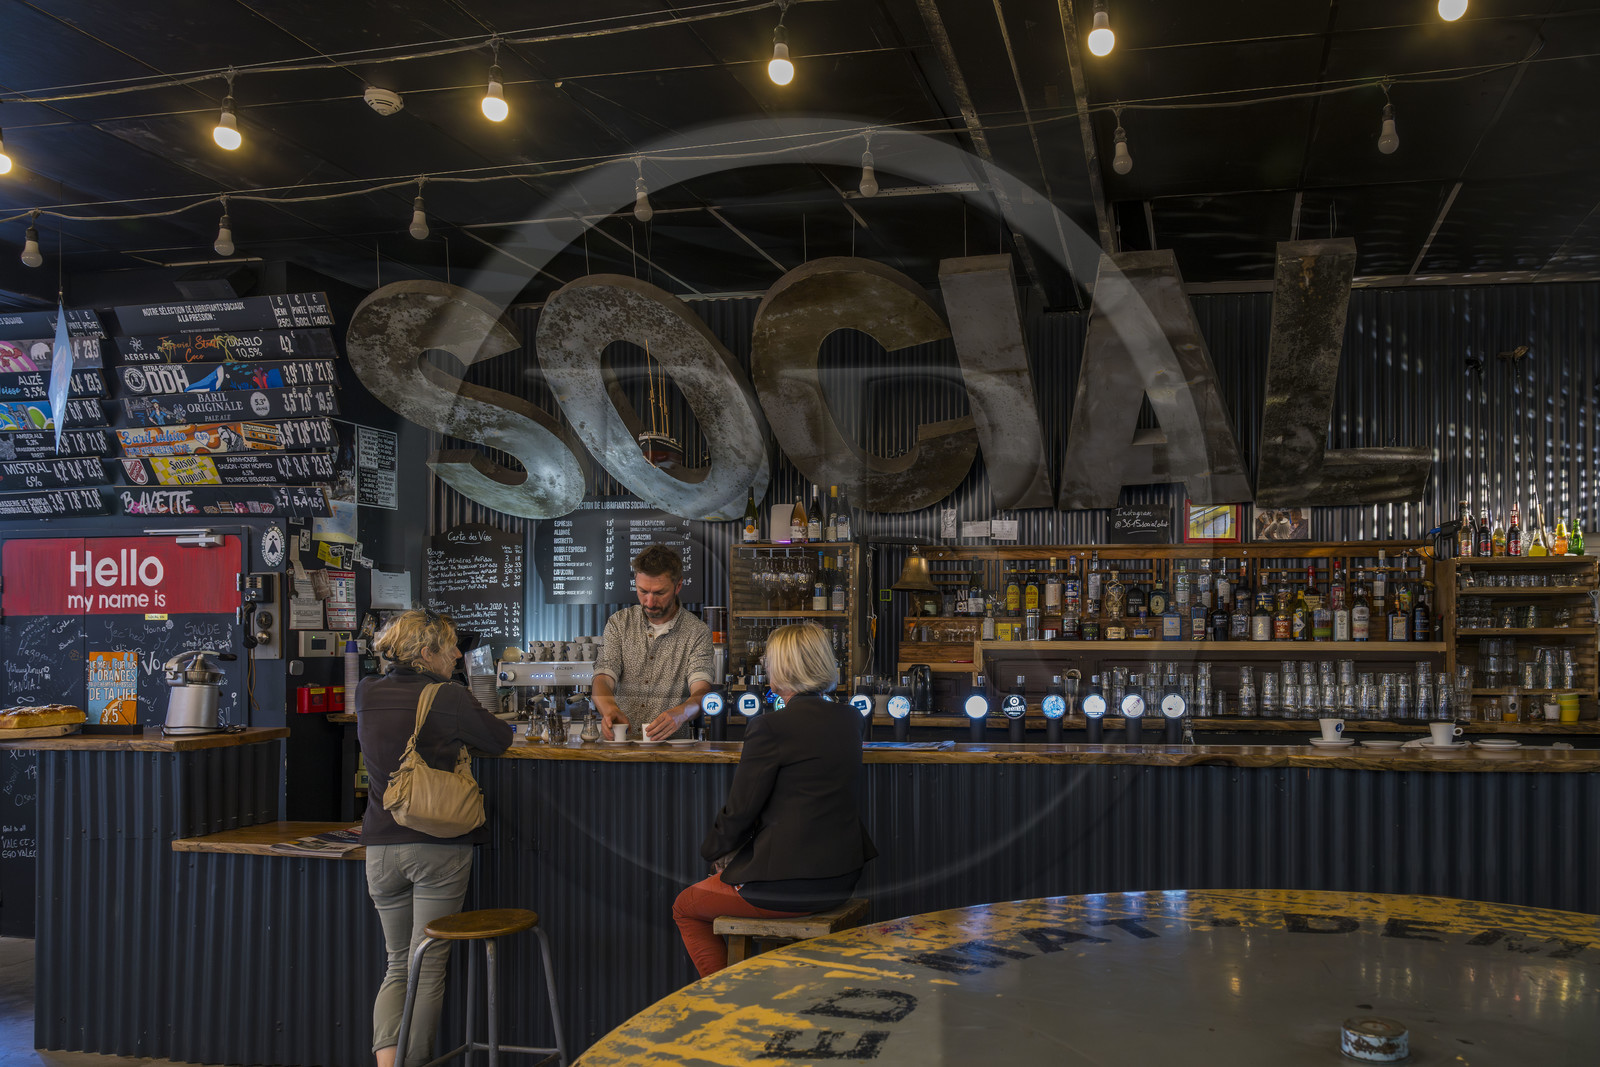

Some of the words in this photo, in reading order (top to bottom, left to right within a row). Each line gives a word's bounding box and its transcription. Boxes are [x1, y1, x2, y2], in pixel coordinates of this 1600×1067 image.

[142, 307, 159, 317] NOTRE
[159, 305, 185, 315] SÉLECTION
[185, 305, 193, 314] DE
[193, 303, 223, 313] LUBRIFIANTS
[223, 301, 245, 311] SOCIAUX
[291, 306, 308, 315] PINTE
[308, 304, 327, 314] PICHET
[190, 312, 213, 322] PRESSION
[295, 317, 312, 327] 50CL
[312, 315, 333, 326] 140CL
[227, 335, 263, 348] DIABLO
[235, 347, 263, 359] 10,5%
[18, 372, 44, 386] ALIZÉ
[145, 371, 190, 394] DDH
[346, 237, 1432, 522] SOCIAL
[23, 386, 46, 398] 3,5%
[196, 391, 229, 403] BARIL
[187, 401, 243, 413] ORIGINALE
[3, 461, 52, 475] MISTRAL
[25, 475, 43, 488] 6%
[120, 490, 195, 516] BAVETTE
[594, 501, 601, 510] DE
[601, 500, 630, 510] LUBRIFIANTS
[1115, 507, 1153, 519] Instagram
[447, 531, 466, 542] Carte
[469, 532, 478, 541] des
[478, 530, 492, 542] Vins
[70, 548, 164, 588] Hello
[67, 593, 96, 612] my
[98, 592, 150, 609] name
[154, 589, 166, 607] is
[89, 660, 97, 670] LE
[89, 688, 101, 701] DE
[103, 688, 115, 701] TA
[117, 688, 137, 701] LIFE
